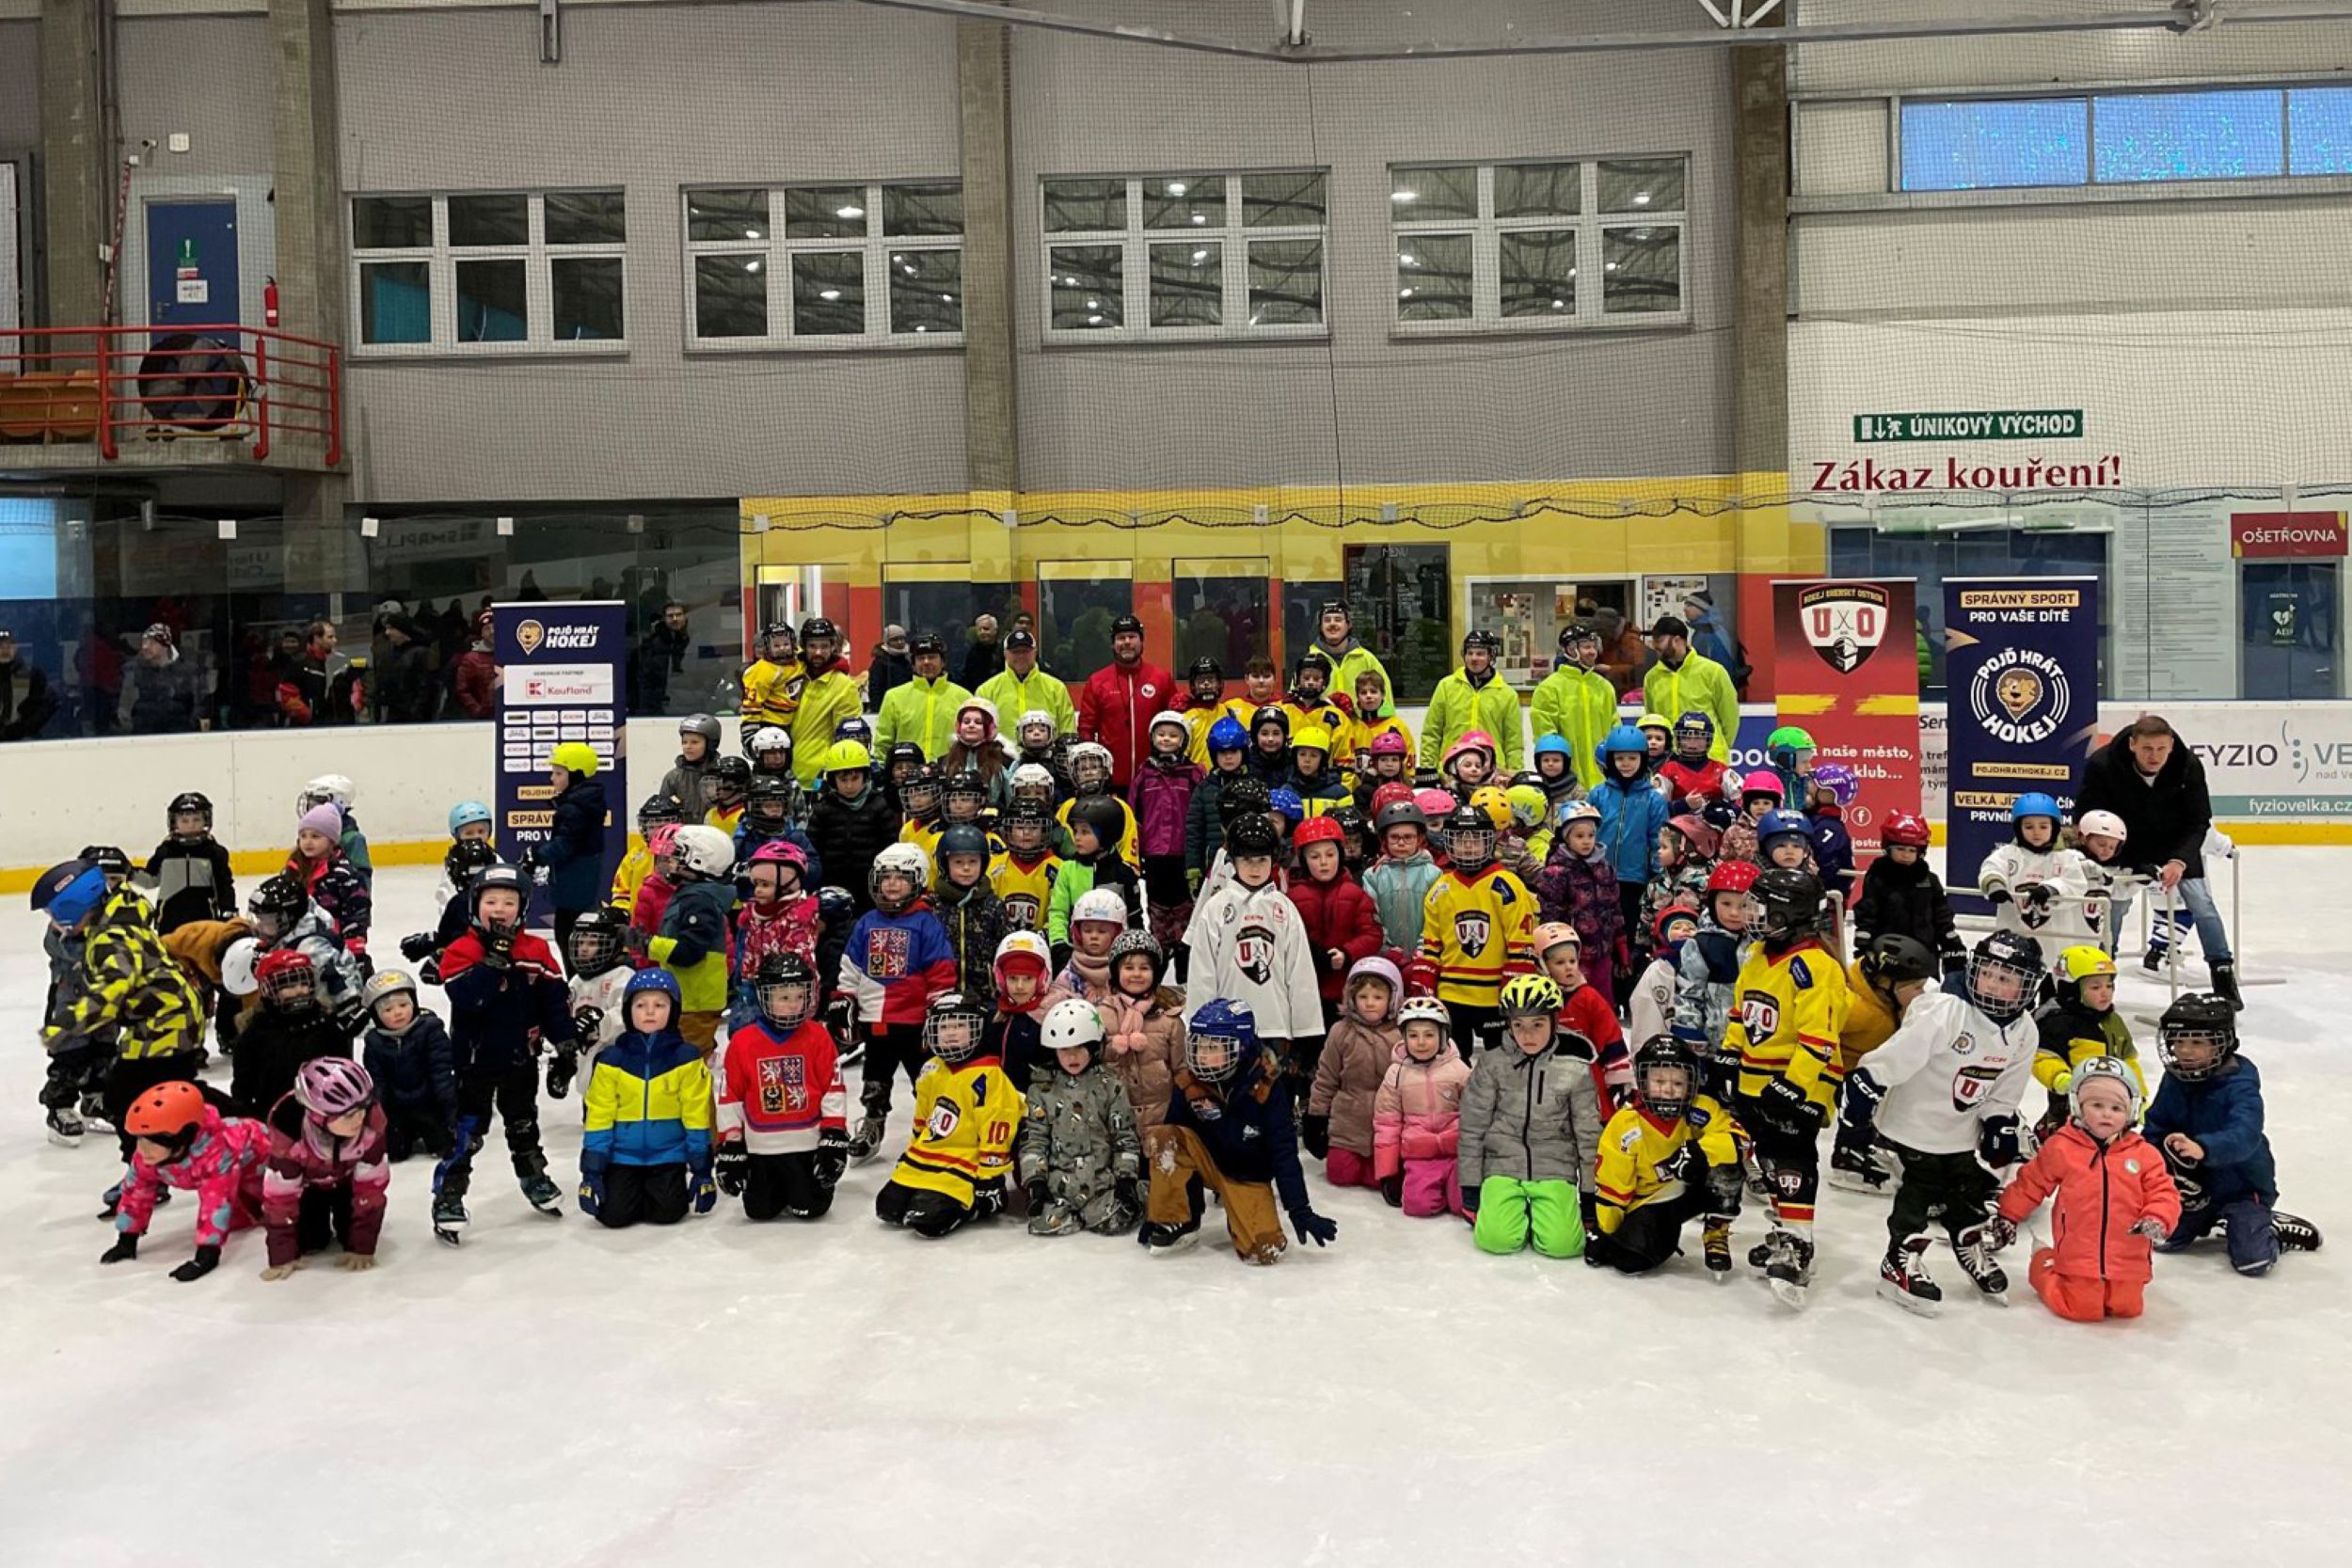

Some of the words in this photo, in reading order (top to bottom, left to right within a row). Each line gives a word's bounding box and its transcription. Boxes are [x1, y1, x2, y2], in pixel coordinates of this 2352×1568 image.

[1910, 414, 1994, 436] ÚNIKOVÝ
[1998, 413, 2075, 435] VÝCHOD
[1812, 458, 1933, 491] Zákaz
[1948, 455, 2121, 489] kouření!
[2242, 527, 2338, 544] OŠETŘOVNA
[1382, 547, 1408, 557] MENU
[1964, 593, 2026, 605] SPRÁVNÝ
[2030, 593, 2075, 604] SPORT
[1969, 611, 1996, 623] PRO
[2000, 609, 2035, 622] VAŠE
[2039, 609, 2070, 622] DÍTĚ
[548, 625, 572, 635] POJĎ
[546, 635, 597, 649] HOKEJ
[1977, 647, 2018, 679] POJĎ
[2020, 649, 2064, 677] HRÁT
[548, 686, 593, 695] Kaufland
[1981, 713, 2058, 743] HOKEJ
[1822, 745, 1858, 756] naše
[1863, 745, 1913, 761] město,
[2189, 744, 2279, 767] FYZIO
[1853, 764, 1902, 779] klub...
[2316, 770, 2337, 779] nad
[1957, 794, 1996, 806] VELKÁ
[2249, 799, 2352, 815] fyziovelka.cz
[512, 813, 552, 825] SPRÁV
[516, 832, 541, 842] PRO
[988, 1120, 1010, 1145] 10
